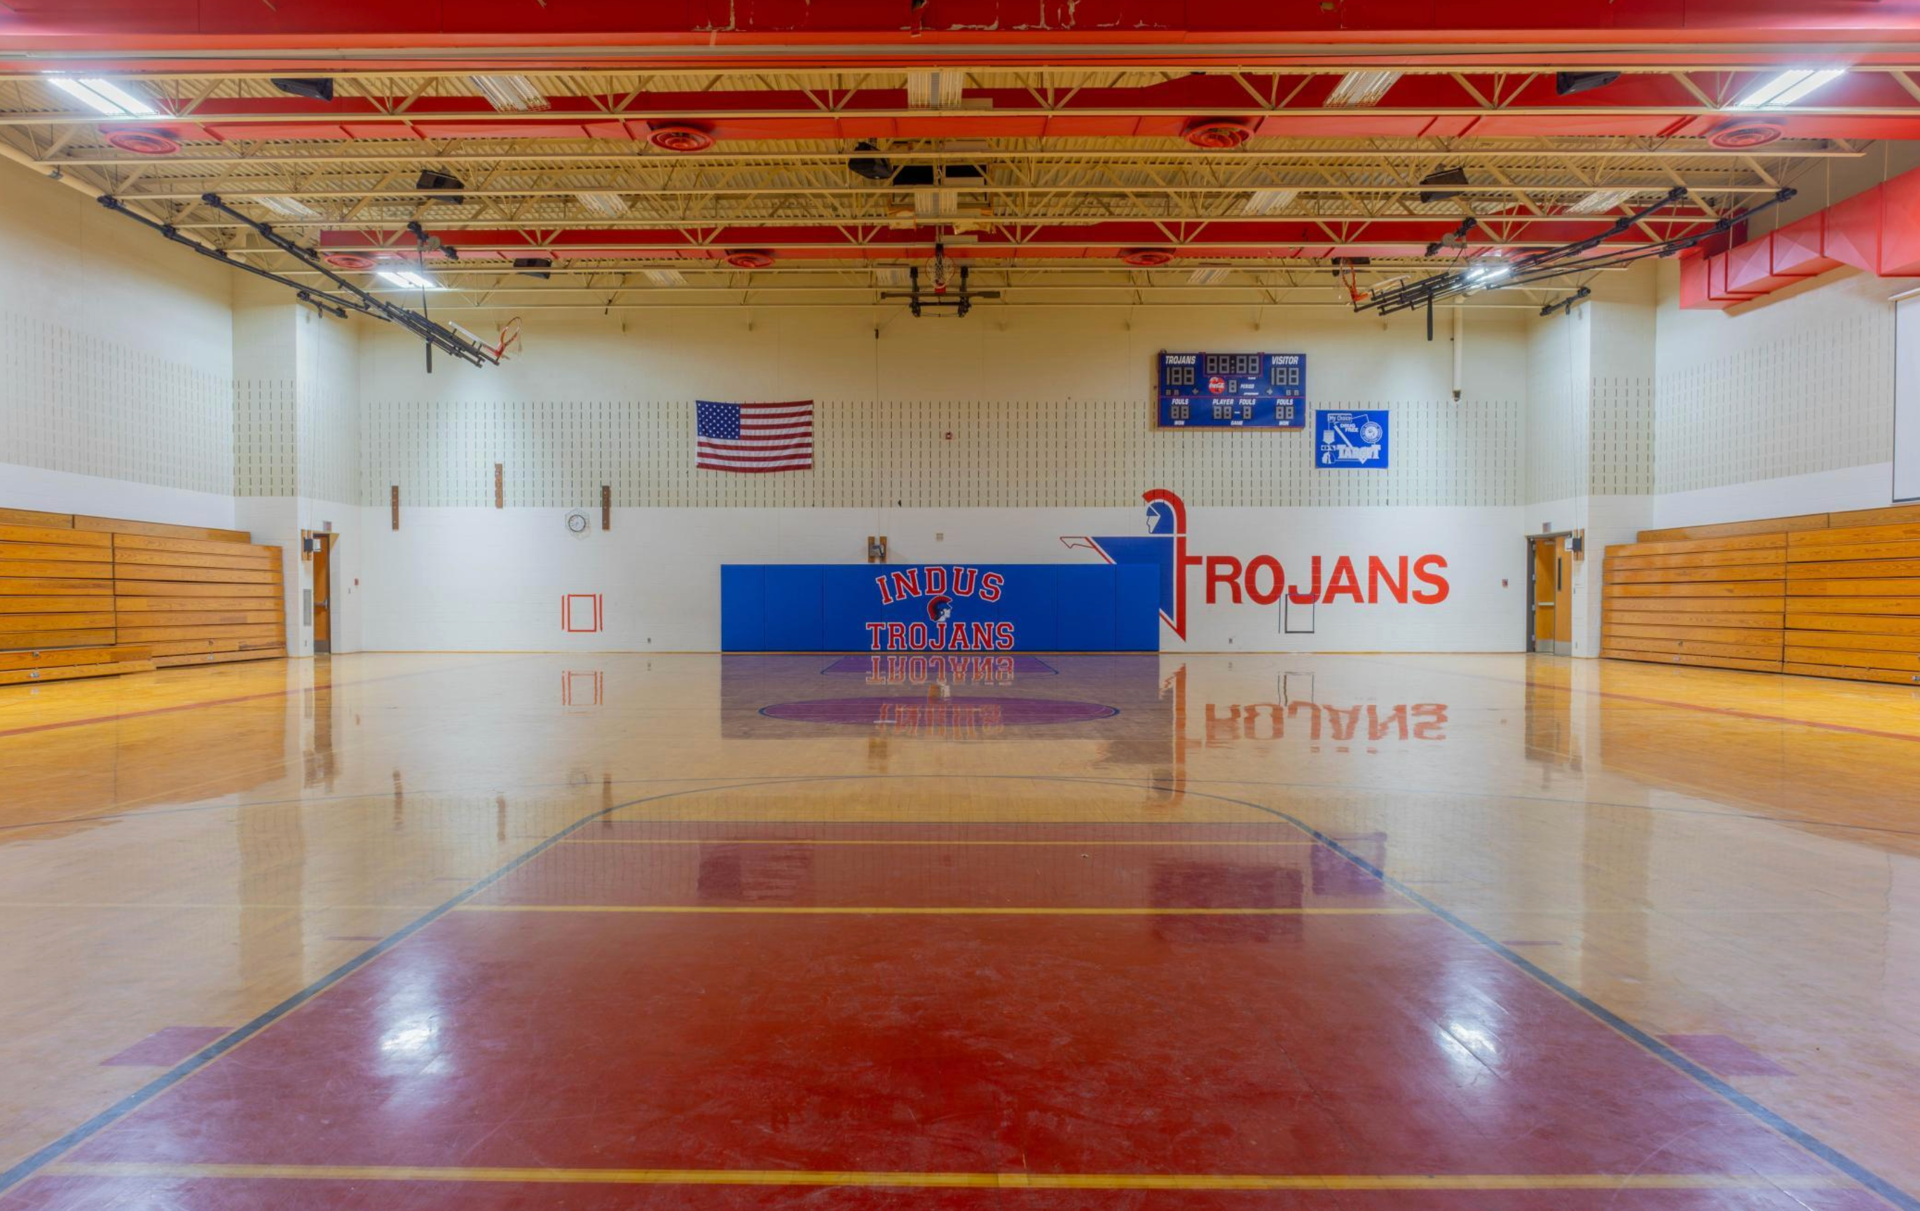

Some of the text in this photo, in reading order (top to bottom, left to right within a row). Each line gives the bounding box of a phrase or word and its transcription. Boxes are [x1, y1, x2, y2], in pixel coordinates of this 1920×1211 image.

[1166, 356, 1196, 365] TROJANS
[1272, 356, 1298, 365] VISITOR
[1336, 444, 1380, 460] TARGET
[875, 566, 1005, 605] INDUS
[865, 621, 1015, 650] TROJANS
